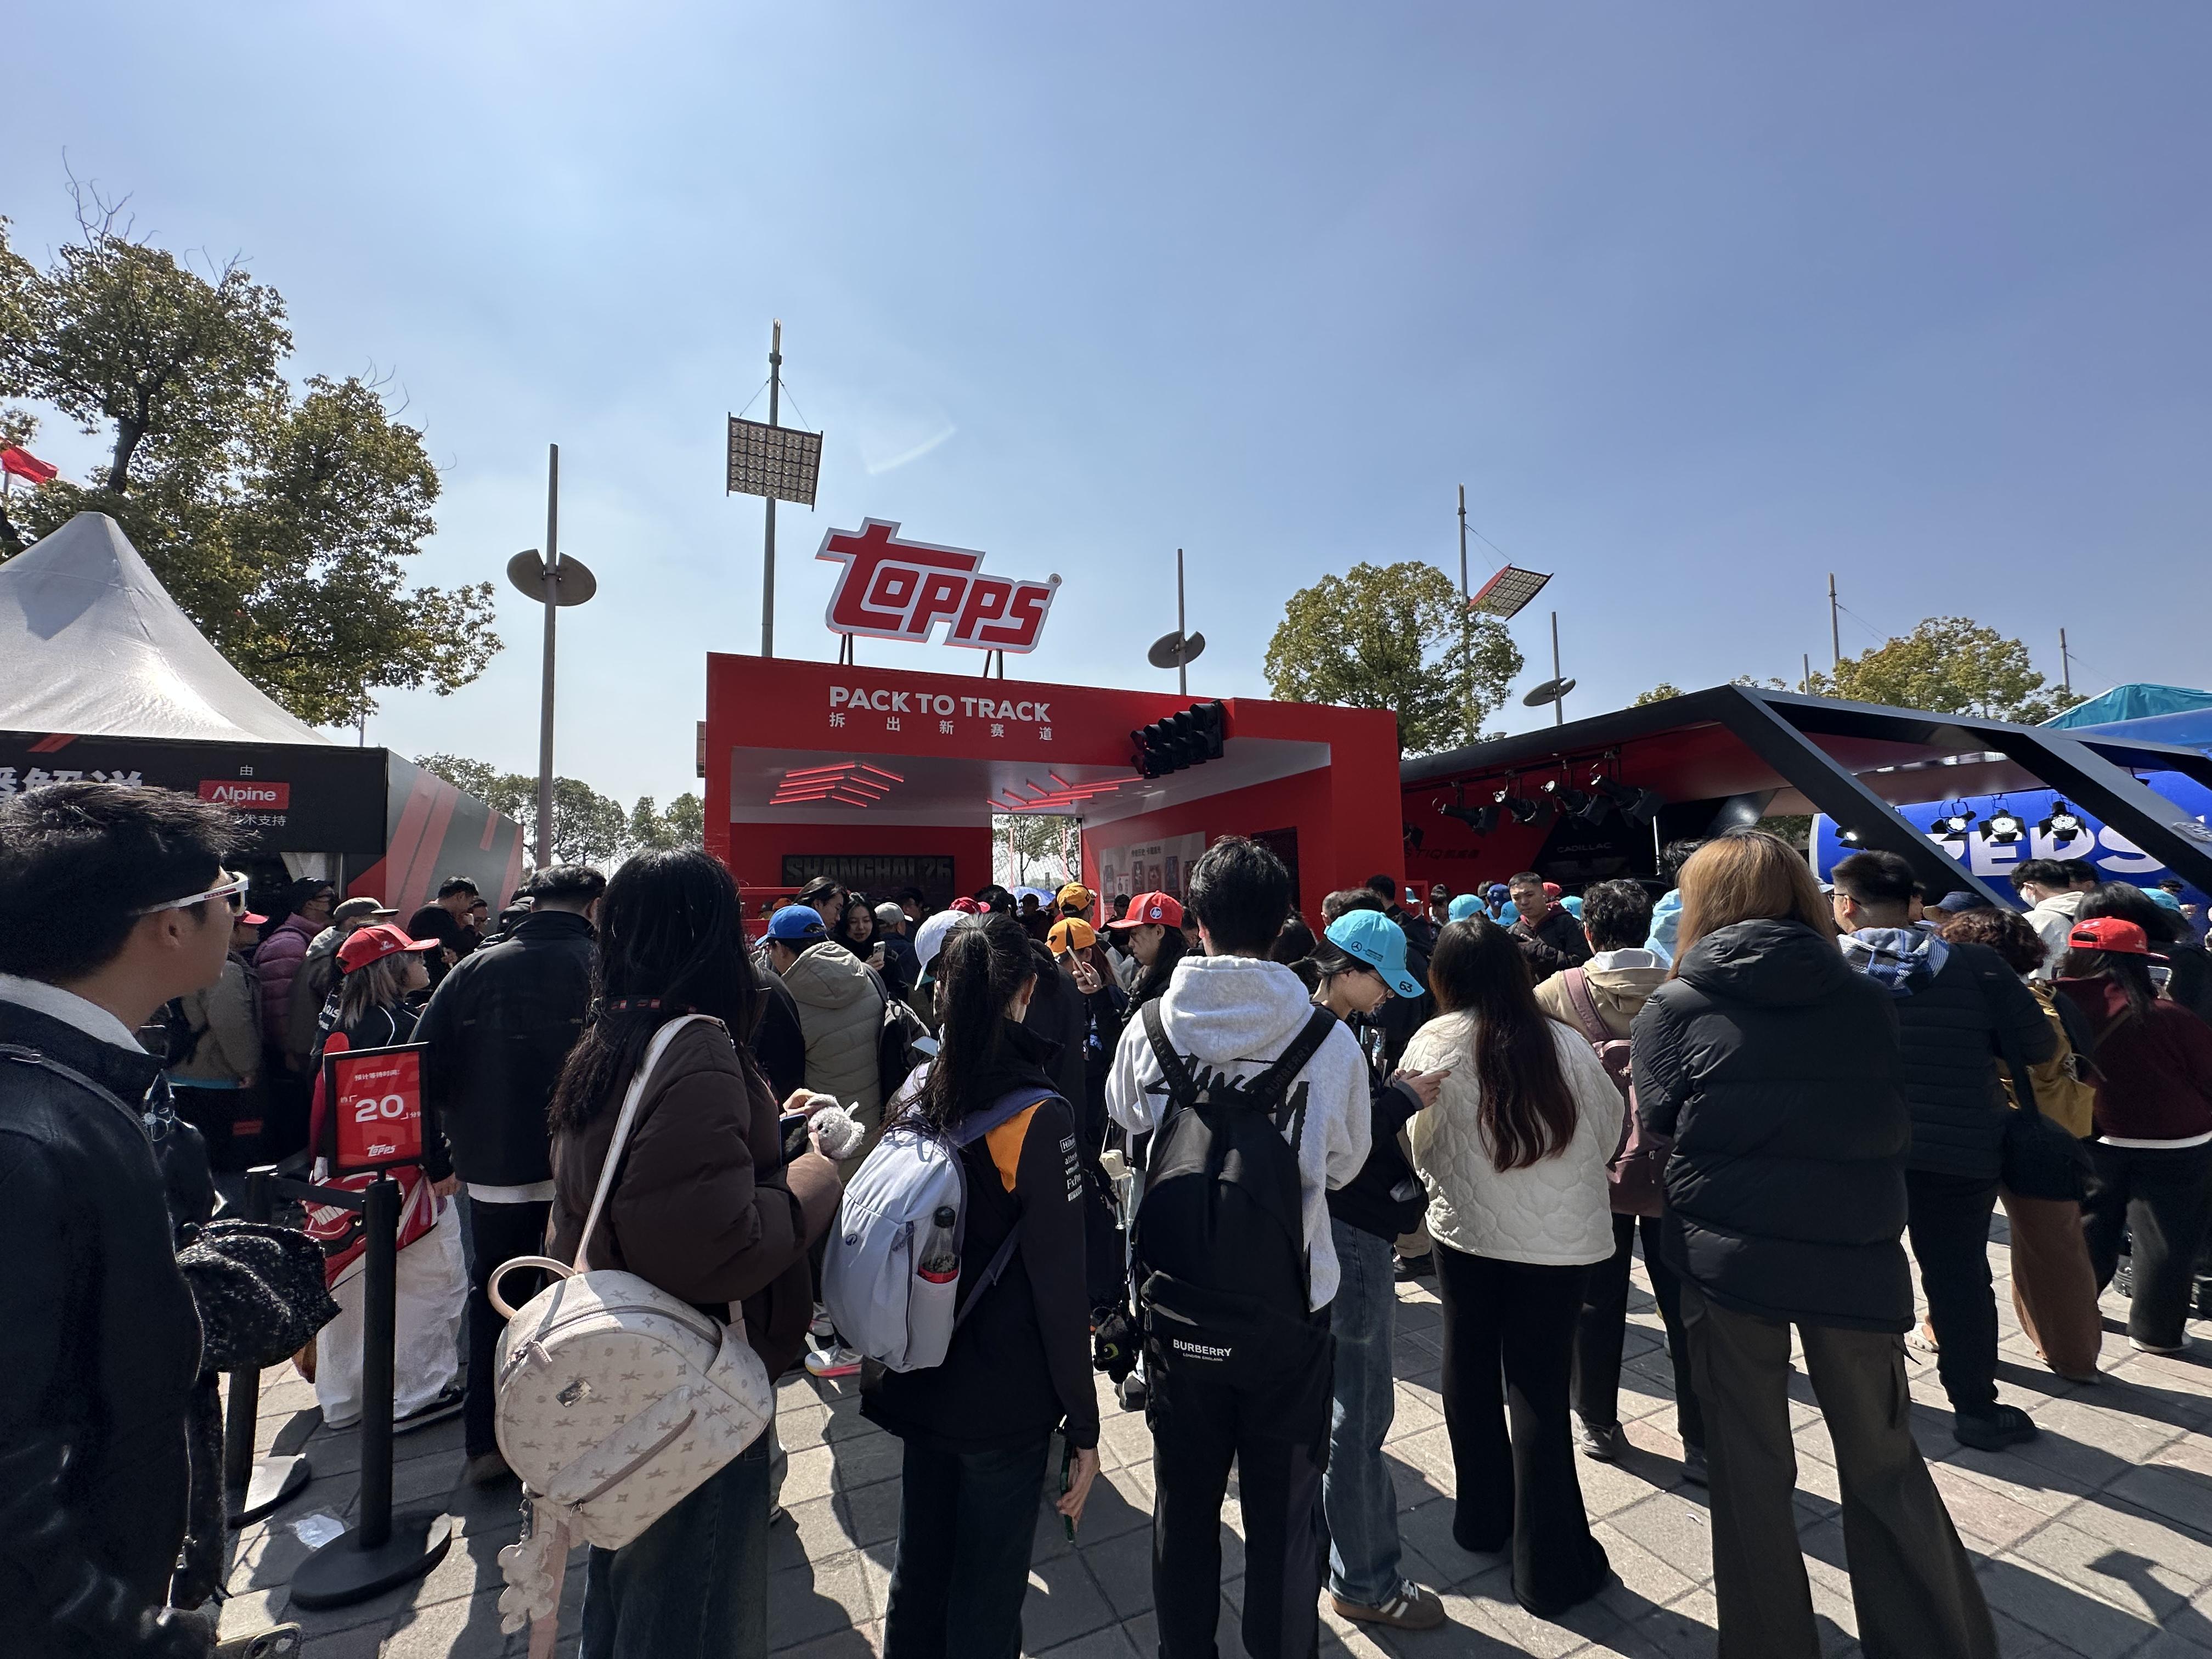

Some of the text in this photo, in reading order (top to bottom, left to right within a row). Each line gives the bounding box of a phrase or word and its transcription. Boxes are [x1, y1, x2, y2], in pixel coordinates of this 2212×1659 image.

[829, 686, 1051, 723] PACK TO TRACK
[829, 712, 1053, 741] 拆出新赛道
[240, 765, 253, 776] 由
[211, 786, 276, 803] Alpine
[1556, 842, 1612, 853] CADILLAC
[786, 857, 915, 883] SHANGHAI
[1399, 980, 1413, 993] 63
[355, 1094, 404, 1122] 20
[1173, 1338, 1232, 1357] BURBERRY
